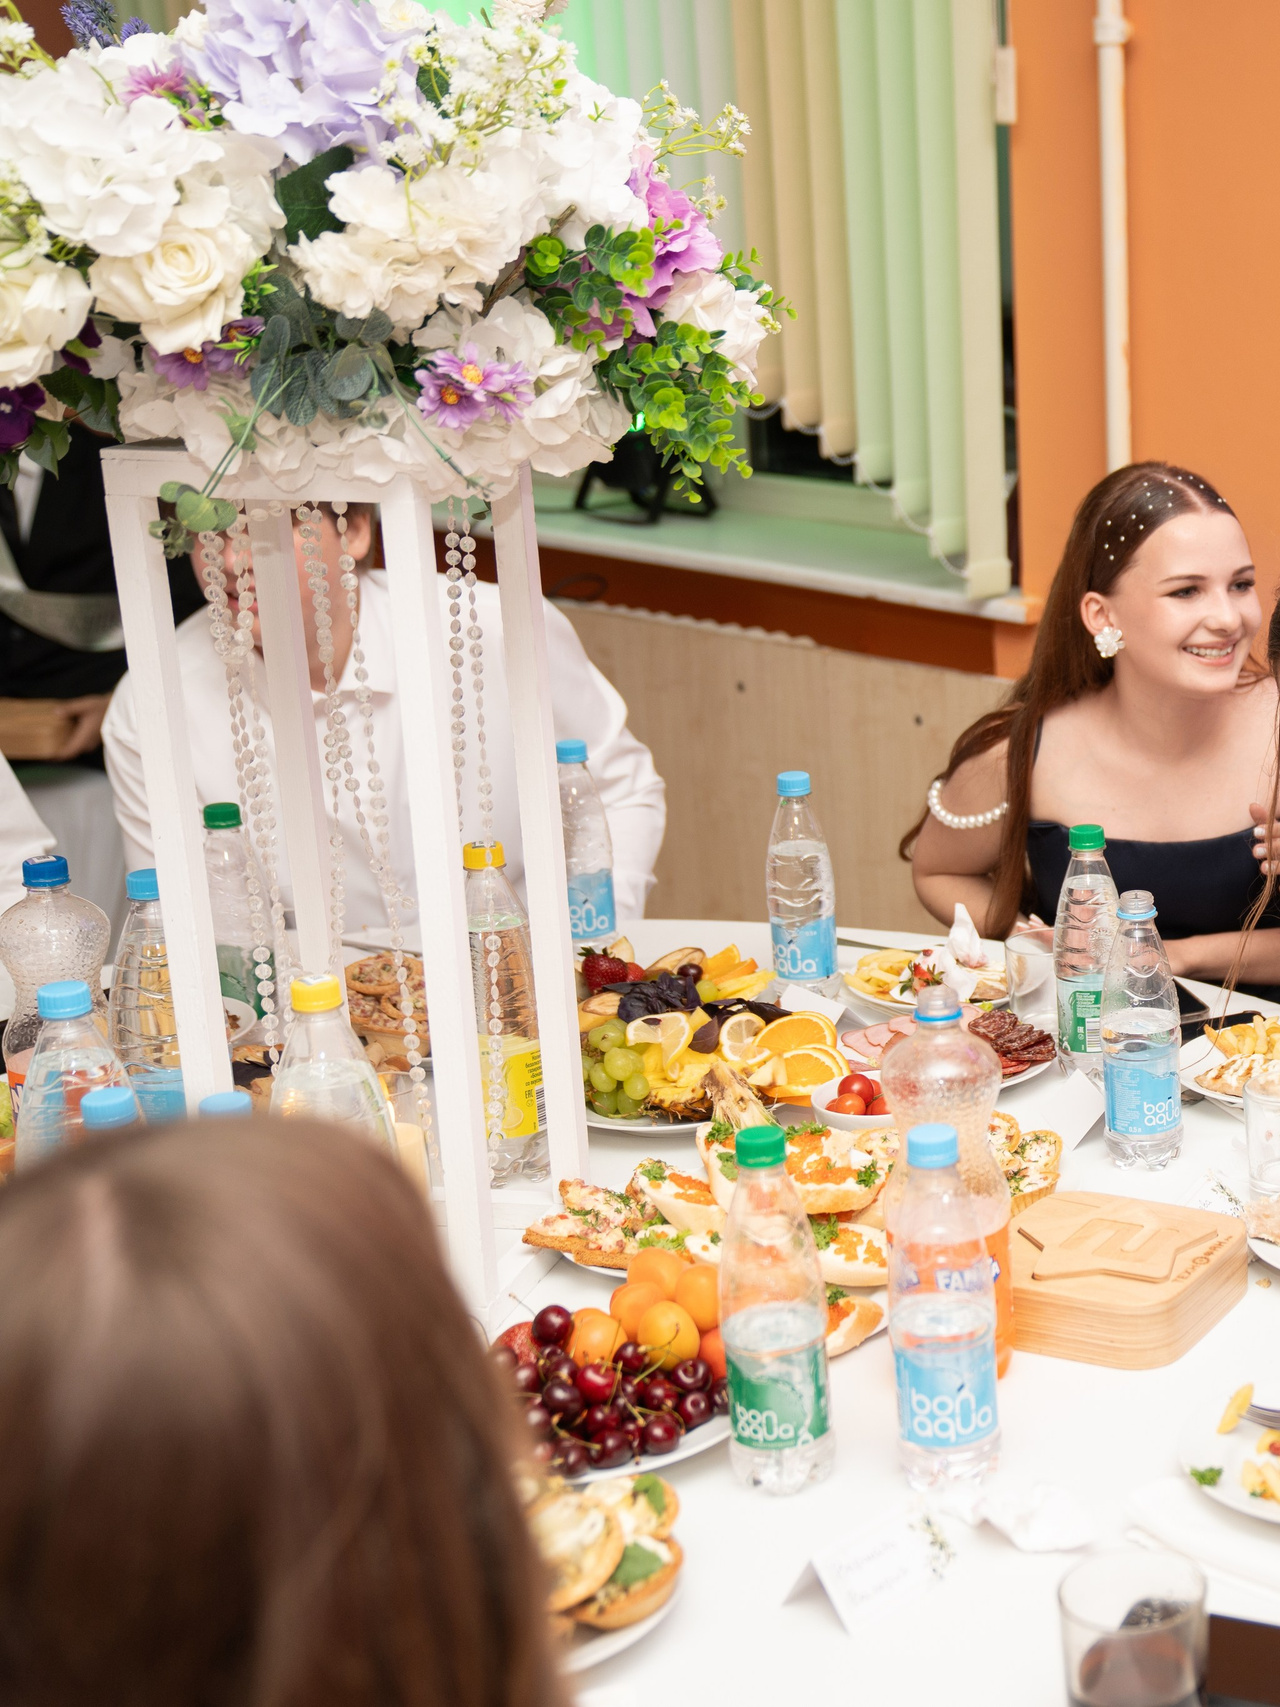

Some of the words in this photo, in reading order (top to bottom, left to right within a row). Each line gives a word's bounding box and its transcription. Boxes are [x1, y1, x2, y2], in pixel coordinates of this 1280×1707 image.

[571, 914, 609, 936] qua
[774, 957, 818, 976] qua
[1144, 1106, 1180, 1127] aqua
[737, 1420, 796, 1443] aqua
[913, 1405, 993, 1443] aqua
